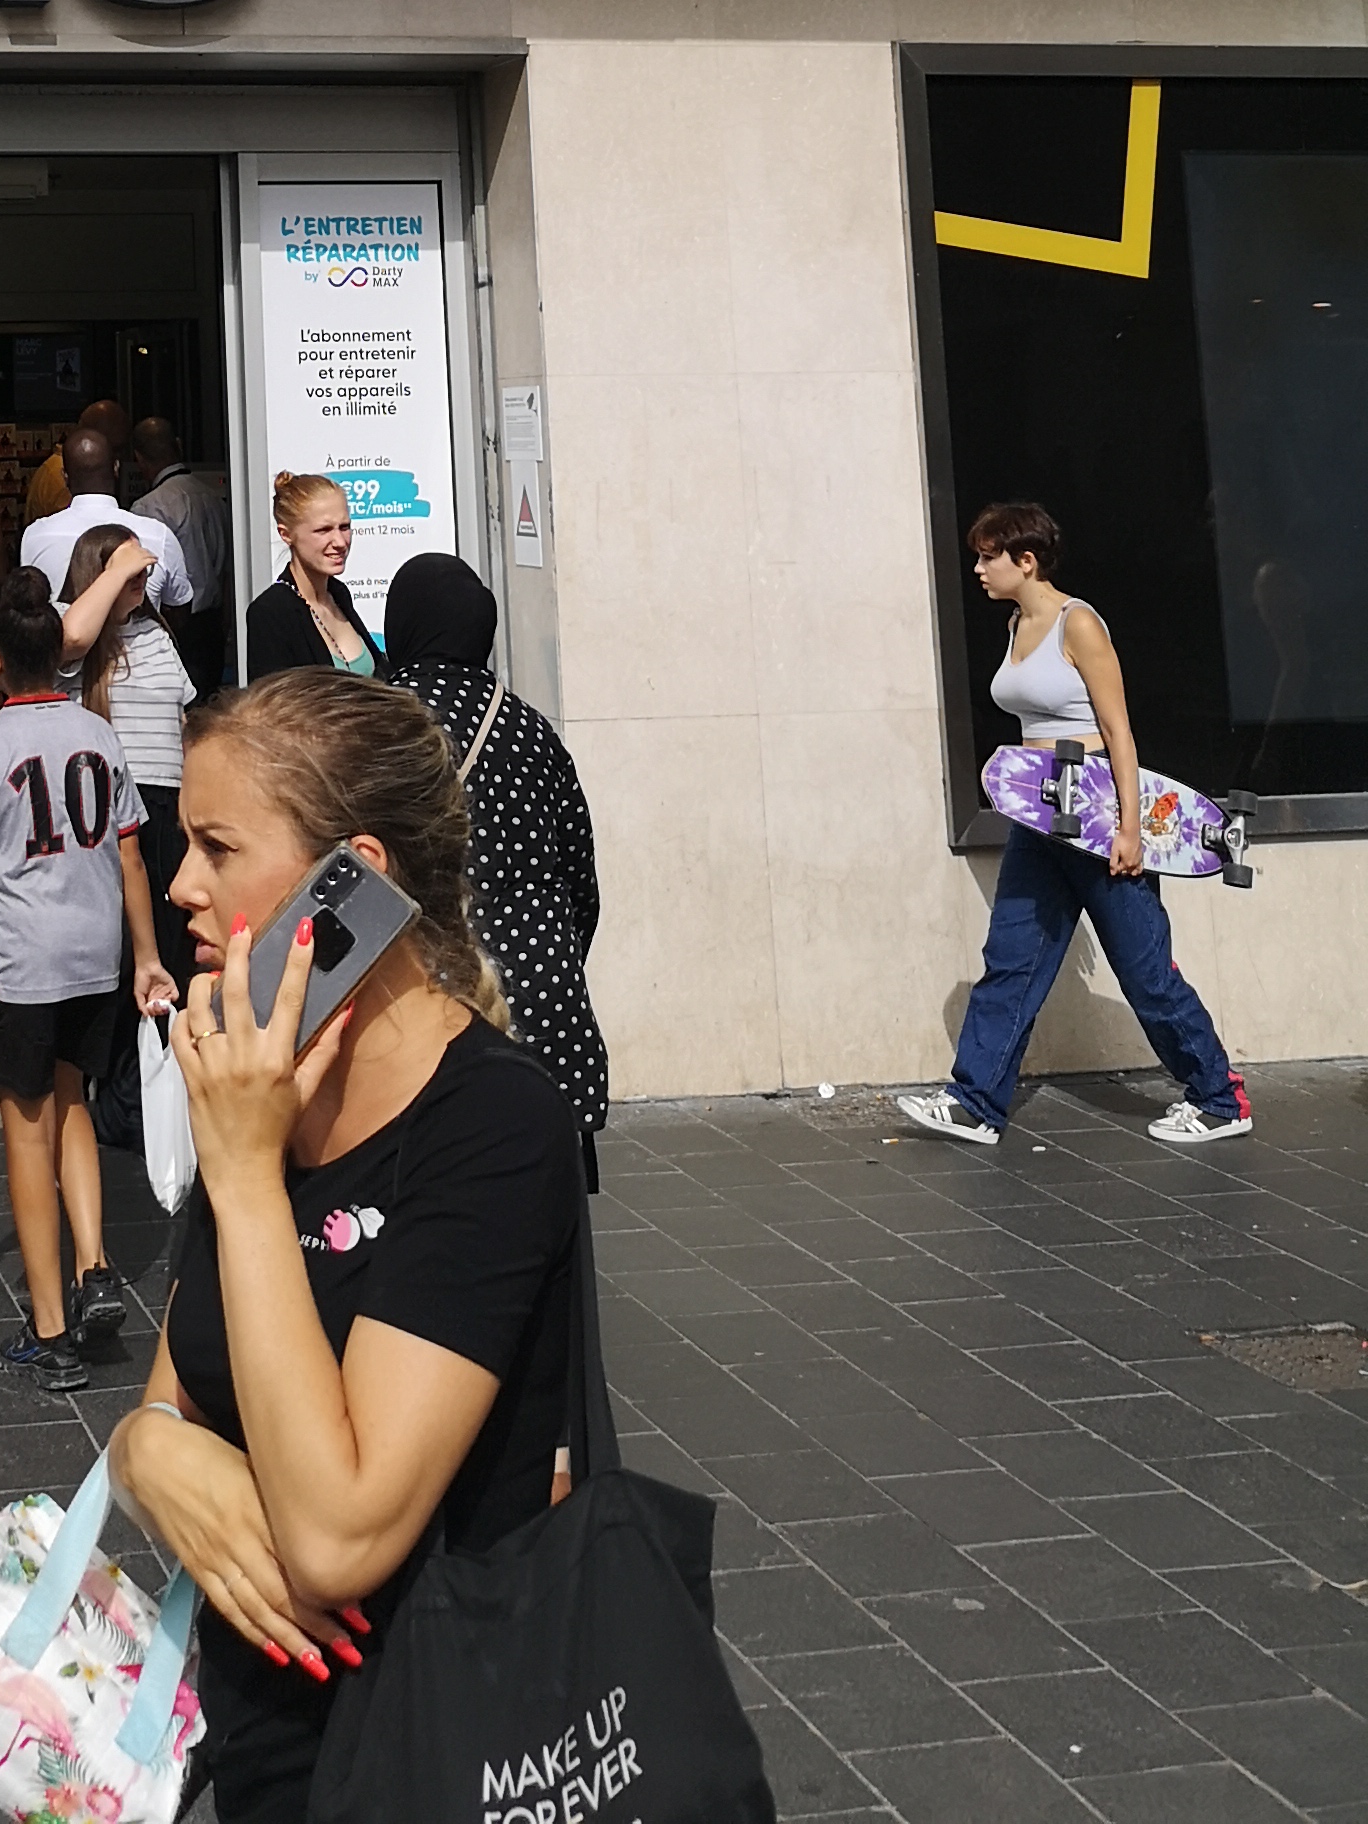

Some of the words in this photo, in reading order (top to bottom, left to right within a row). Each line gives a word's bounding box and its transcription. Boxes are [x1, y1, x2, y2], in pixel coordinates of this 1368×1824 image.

[281, 216, 422, 236] L'ENTRETIEN
[286, 239, 419, 262] RÉPARATION
[373, 266, 403, 277] Darty
[373, 278, 399, 287] MAX
[301, 329, 412, 343] L'abonnement
[298, 351, 335, 364] pour
[339, 346, 416, 360] entretenir
[319, 368, 334, 379] et
[339, 365, 397, 381] réparer
[306, 387, 332, 397] vos
[337, 383, 411, 400] appareils
[322, 406, 341, 416] en
[346, 402, 397, 415] illimité
[326, 454, 334, 467] À
[338, 456, 371, 469] partir
[375, 457, 390, 466] de
[378, 526, 389, 534] 12
[391, 525, 414, 534] mois
[354, 592, 370, 600] plus
[7, 750, 111, 860] 10
[483, 1725, 582, 1804] MAKE
[586, 1685, 626, 1750] UP
